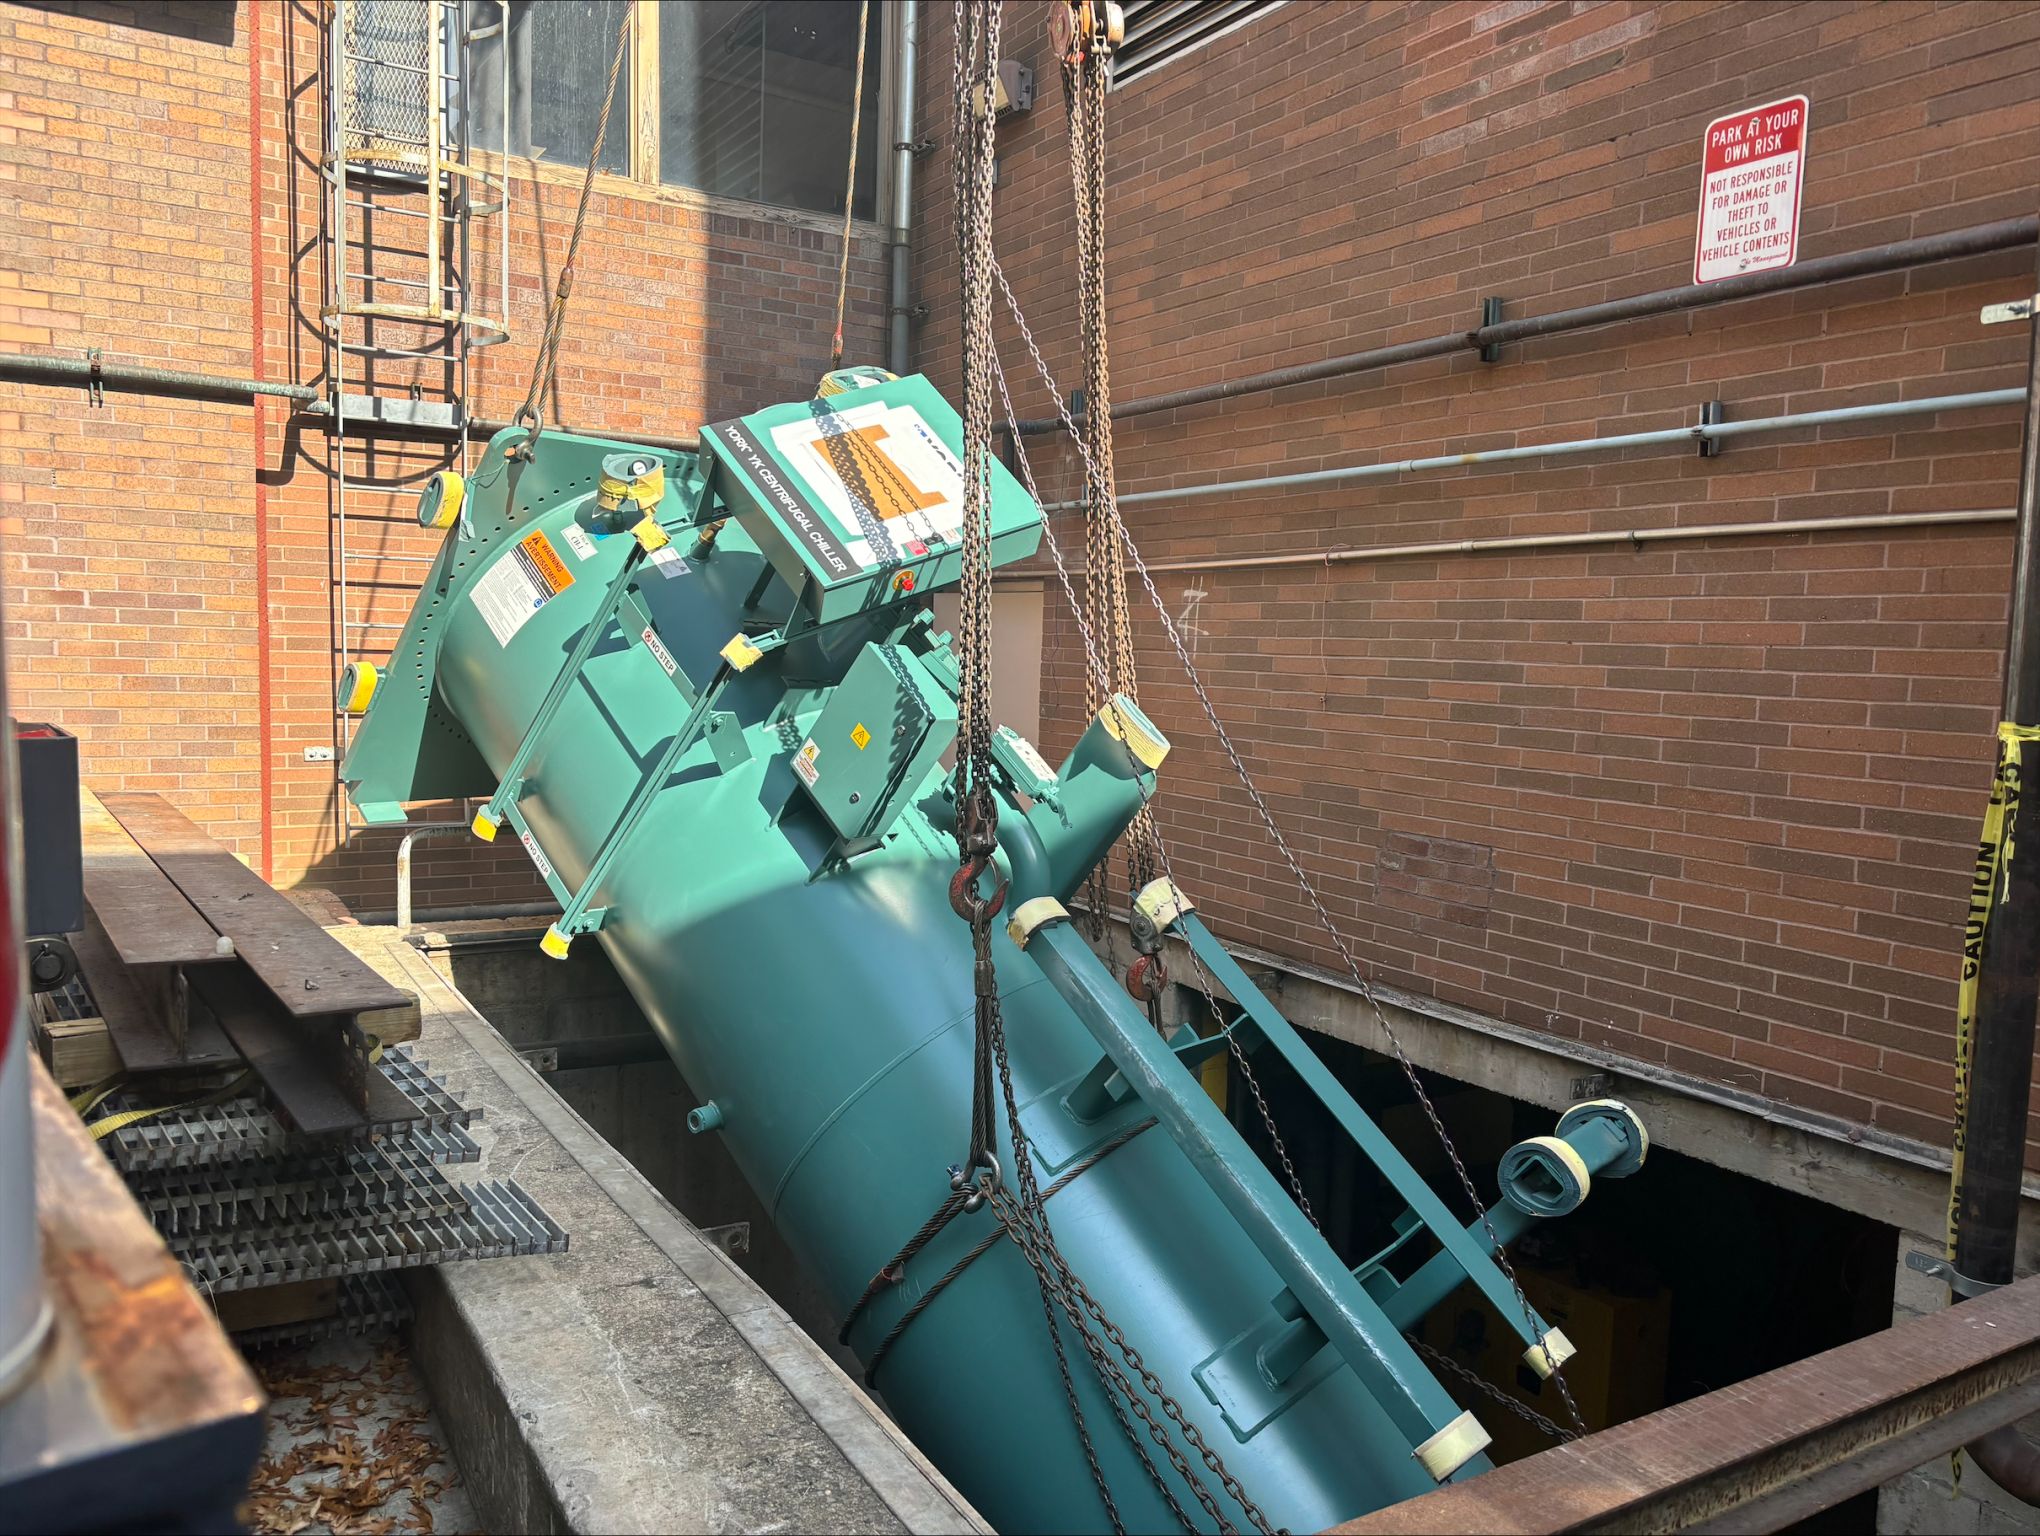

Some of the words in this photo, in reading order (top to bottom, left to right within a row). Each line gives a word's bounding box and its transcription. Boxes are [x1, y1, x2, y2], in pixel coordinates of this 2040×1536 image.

[1712, 124, 1742, 148] PARK
[1747, 119, 1760, 139] AT
[1766, 108, 1799, 132] YOUR
[1724, 144, 1749, 163] OWN
[1755, 133, 1783, 154] RISK
[1710, 179, 1727, 194] NOT
[1730, 161, 1793, 189] RESPONSIBLE
[1712, 195, 1730, 210] FOR
[1733, 185, 1770, 206] DAMAGE
[1774, 180, 1788, 195] OR
[1728, 206, 1754, 223] THEFT
[1757, 202, 1769, 216] TO
[1717, 221, 1760, 242] VEHICLES
[1764, 217, 1777, 231] OR
[1702, 241, 1740, 262] VEHICLE
[1743, 231, 1790, 254] CONTENTS
[1741, 257, 1752, 267] The
[1752, 251, 1788, 264] Management
[725, 425, 752, 452] YORK
[748, 454, 766, 469] YK
[759, 469, 813, 532] CENTRIFUGAL
[809, 531, 847, 572] CHILLER
[525, 541, 562, 588] AVERTISSEMENT
[542, 543, 564, 573] WARNING
[650, 640, 660, 653] NO
[658, 651, 674, 671] STEP
[529, 843, 537, 855] NO
[536, 856, 549, 872] STEP
[1963, 842, 1997, 981] CAUTION
